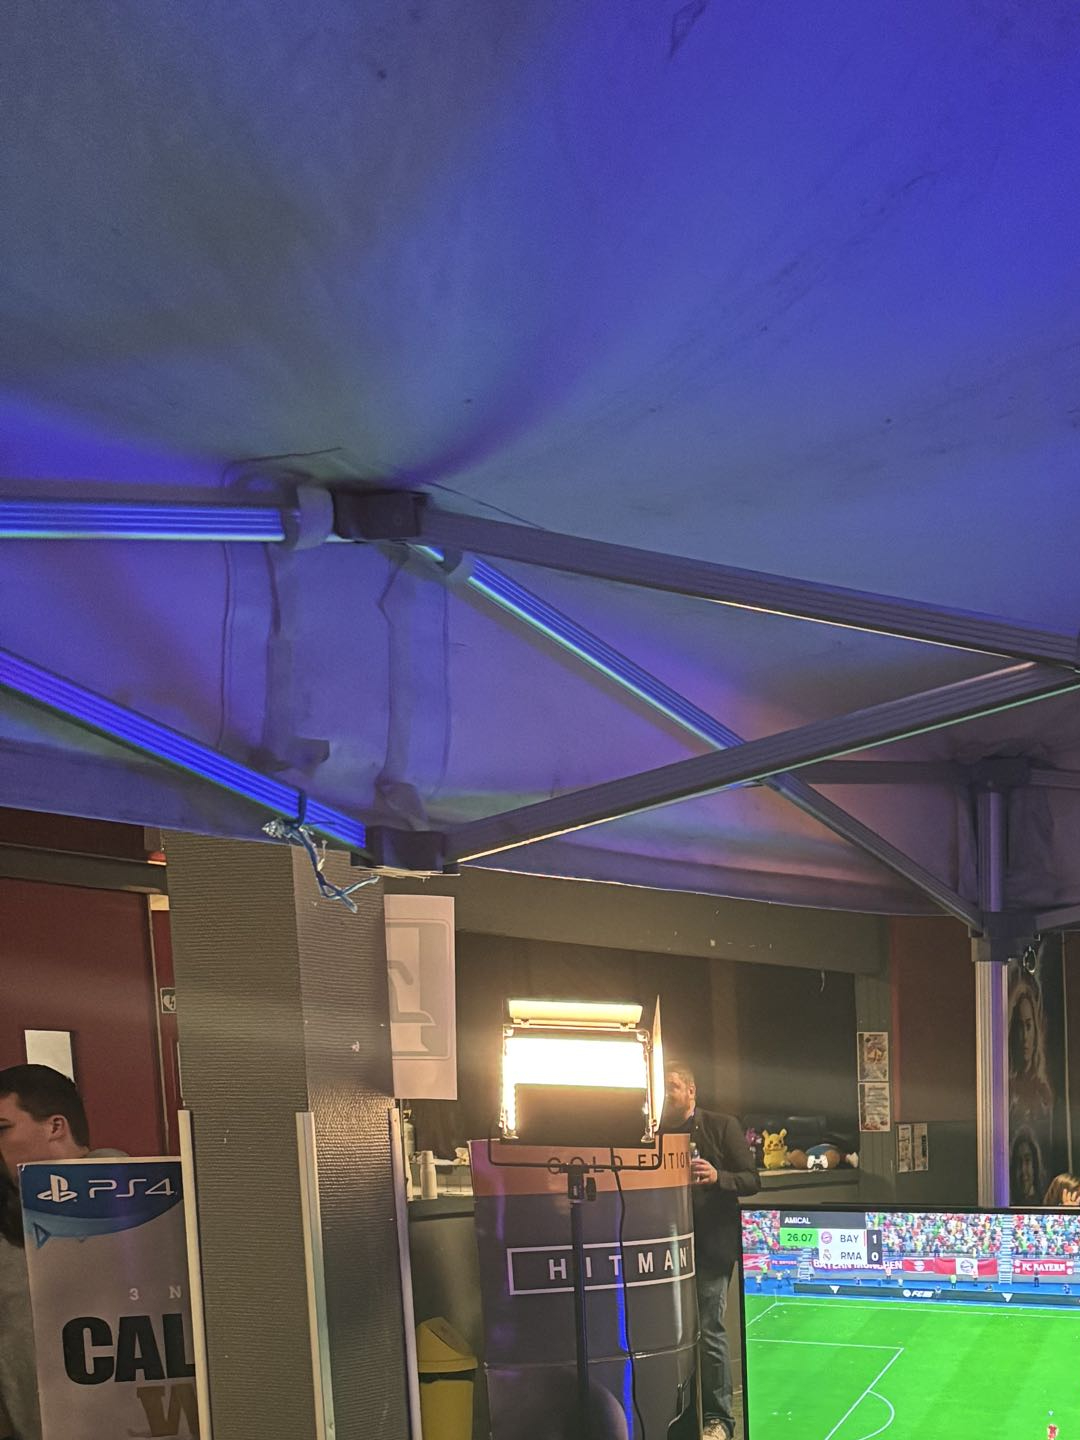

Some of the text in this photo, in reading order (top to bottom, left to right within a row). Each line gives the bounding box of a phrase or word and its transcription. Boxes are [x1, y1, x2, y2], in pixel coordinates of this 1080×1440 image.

[88, 1177, 176, 1199] PS4
[784, 1216, 811, 1225] AMICAL
[840, 1234, 859, 1243] BAY
[871, 1234, 878, 1245] 1
[840, 1251, 879, 1262] RMA 0
[549, 1252, 687, 1280] HITMAN
[129, 1288, 139, 1300] 3
